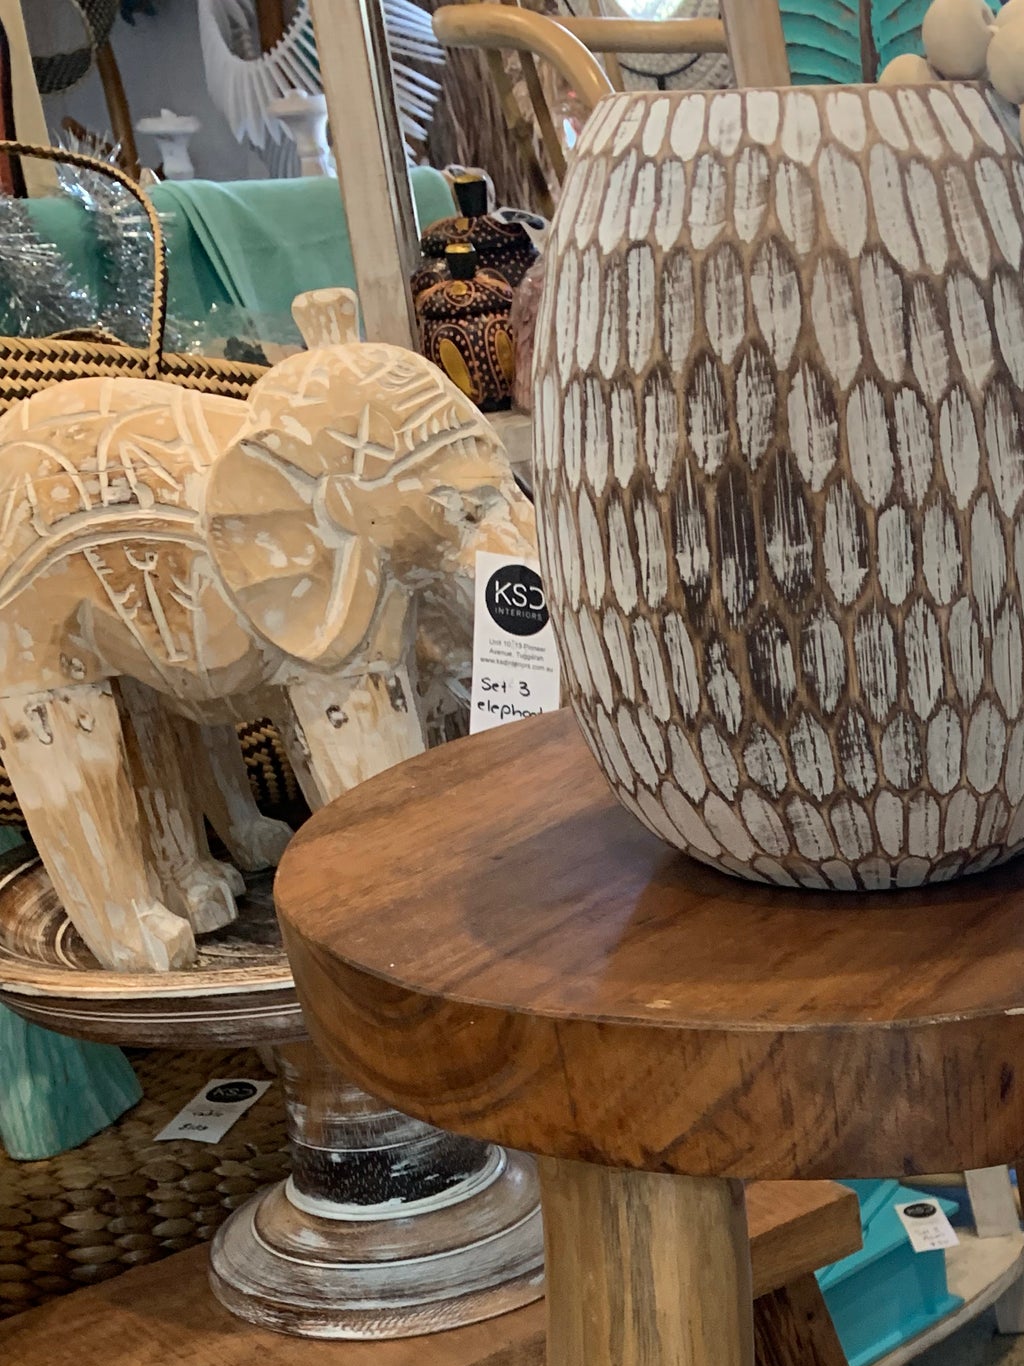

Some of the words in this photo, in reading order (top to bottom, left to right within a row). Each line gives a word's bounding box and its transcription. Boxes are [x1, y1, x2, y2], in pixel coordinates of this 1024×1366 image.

[494, 607, 543, 622] INTERIORS
[481, 677, 507, 693] Set
[519, 681, 531, 697] 3
